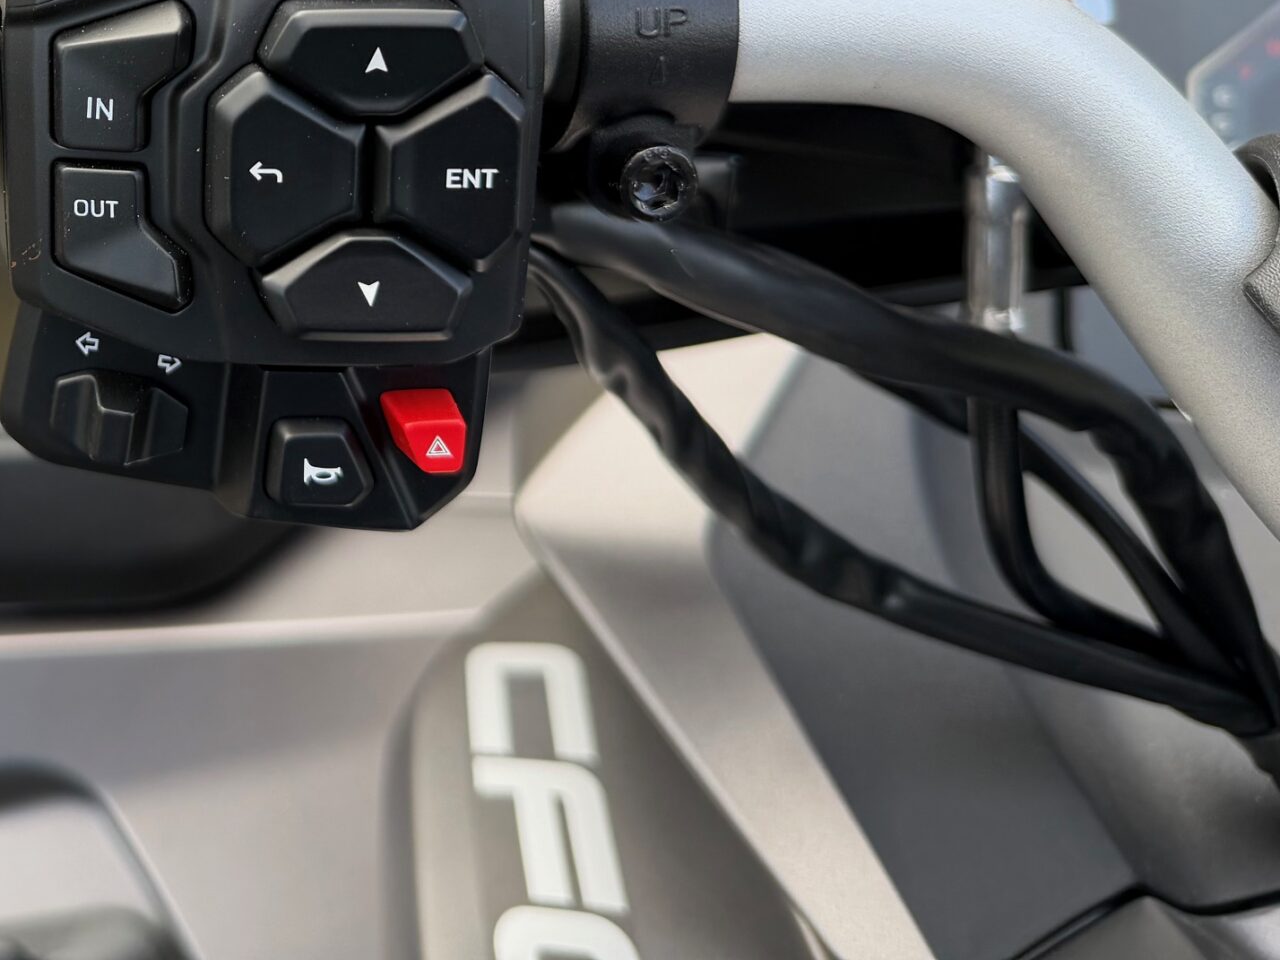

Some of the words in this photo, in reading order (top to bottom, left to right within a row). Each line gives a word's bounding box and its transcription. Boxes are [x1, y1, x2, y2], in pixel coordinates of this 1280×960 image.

[634, 6, 689, 39] UP
[86, 95, 115, 122] IN
[445, 168, 500, 190] ENT
[73, 198, 120, 220] OUT
